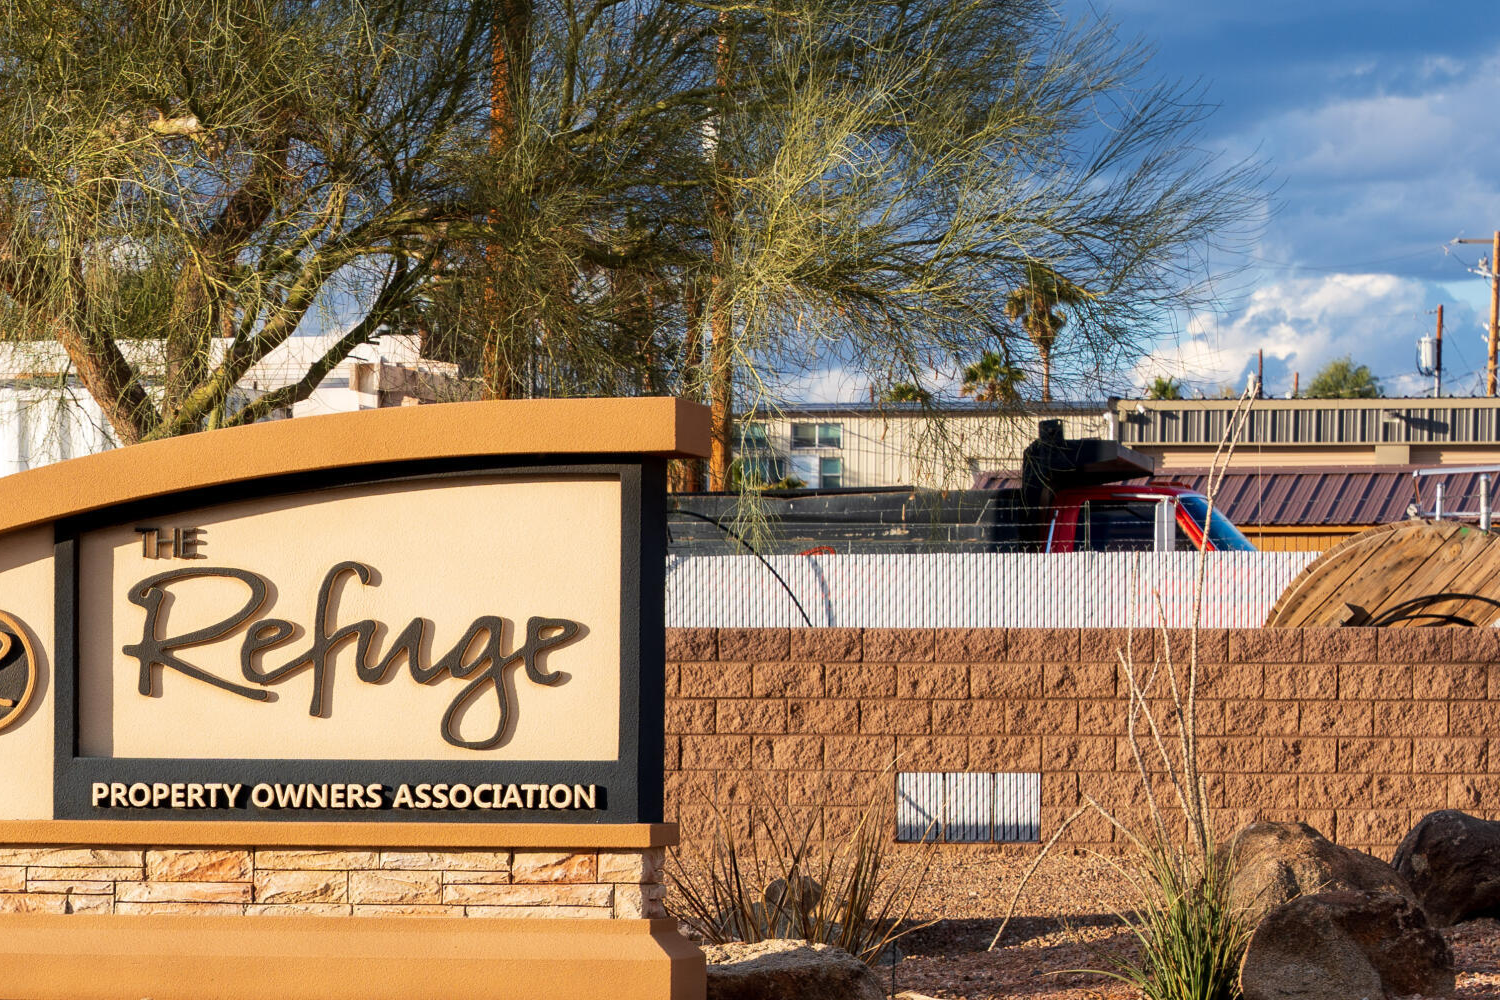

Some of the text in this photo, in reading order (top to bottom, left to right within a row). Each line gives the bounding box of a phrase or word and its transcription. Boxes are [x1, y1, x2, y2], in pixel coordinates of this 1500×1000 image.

[134, 526, 203, 559] THE
[122, 560, 580, 748] Refuge
[92, 783, 596, 810] PROPERTY OWNERS ASSOCIATION
